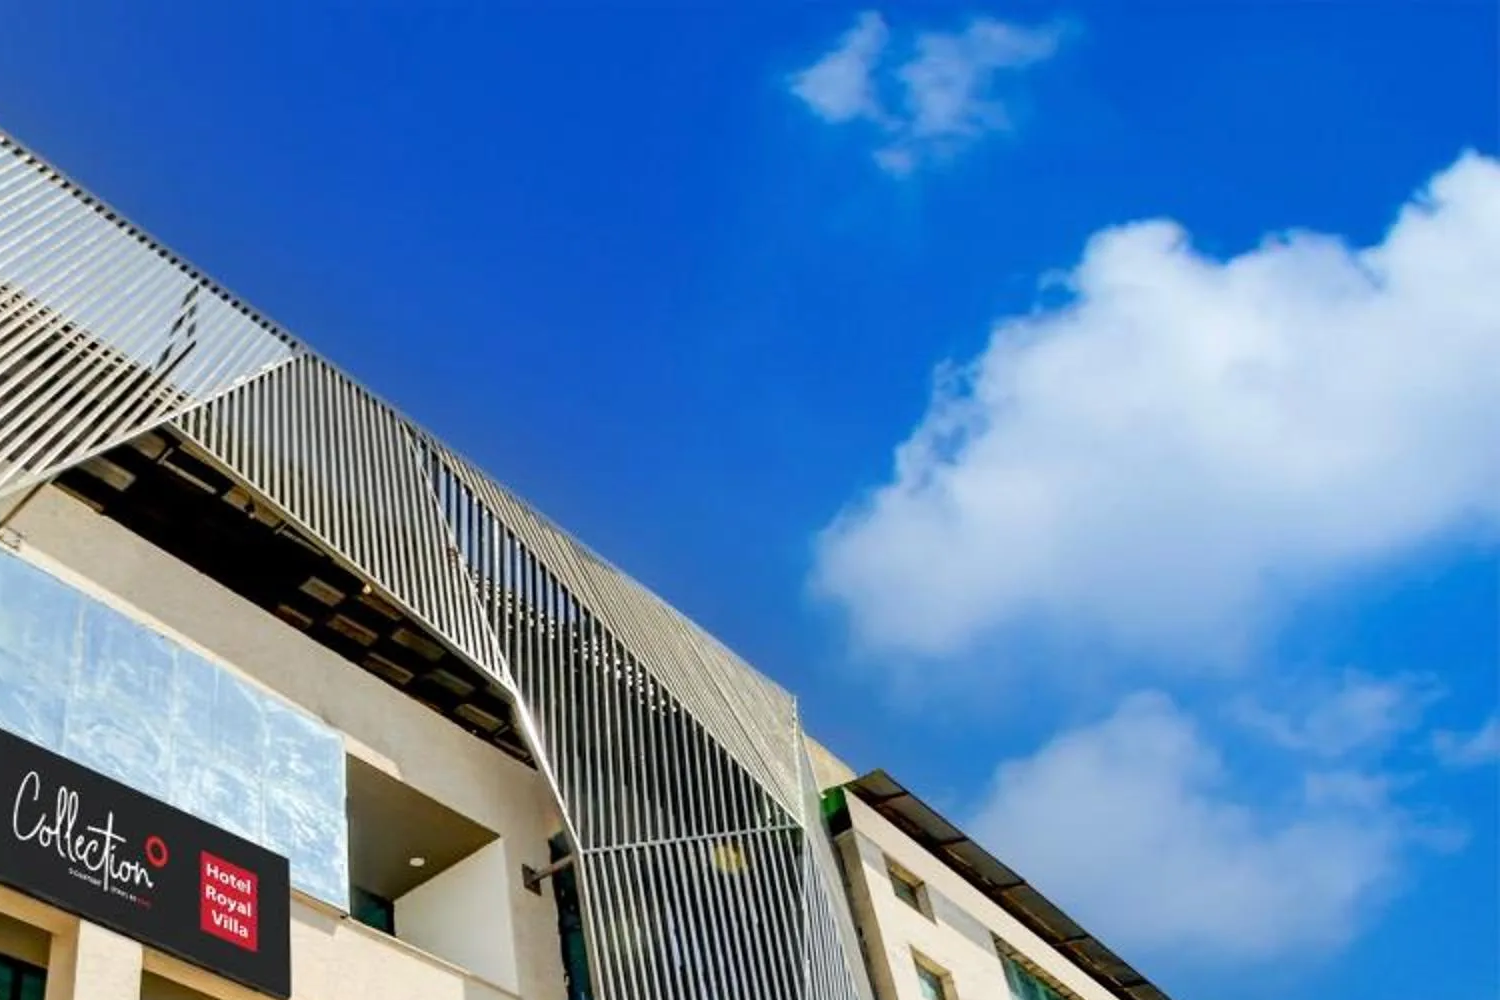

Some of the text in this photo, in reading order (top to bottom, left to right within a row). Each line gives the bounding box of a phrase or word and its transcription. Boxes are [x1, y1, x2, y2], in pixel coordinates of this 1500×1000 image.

[13, 770, 154, 892] Collection
[206, 863, 251, 895] Hotel
[205, 884, 252, 918] Royal
[211, 909, 249, 939] Villa
